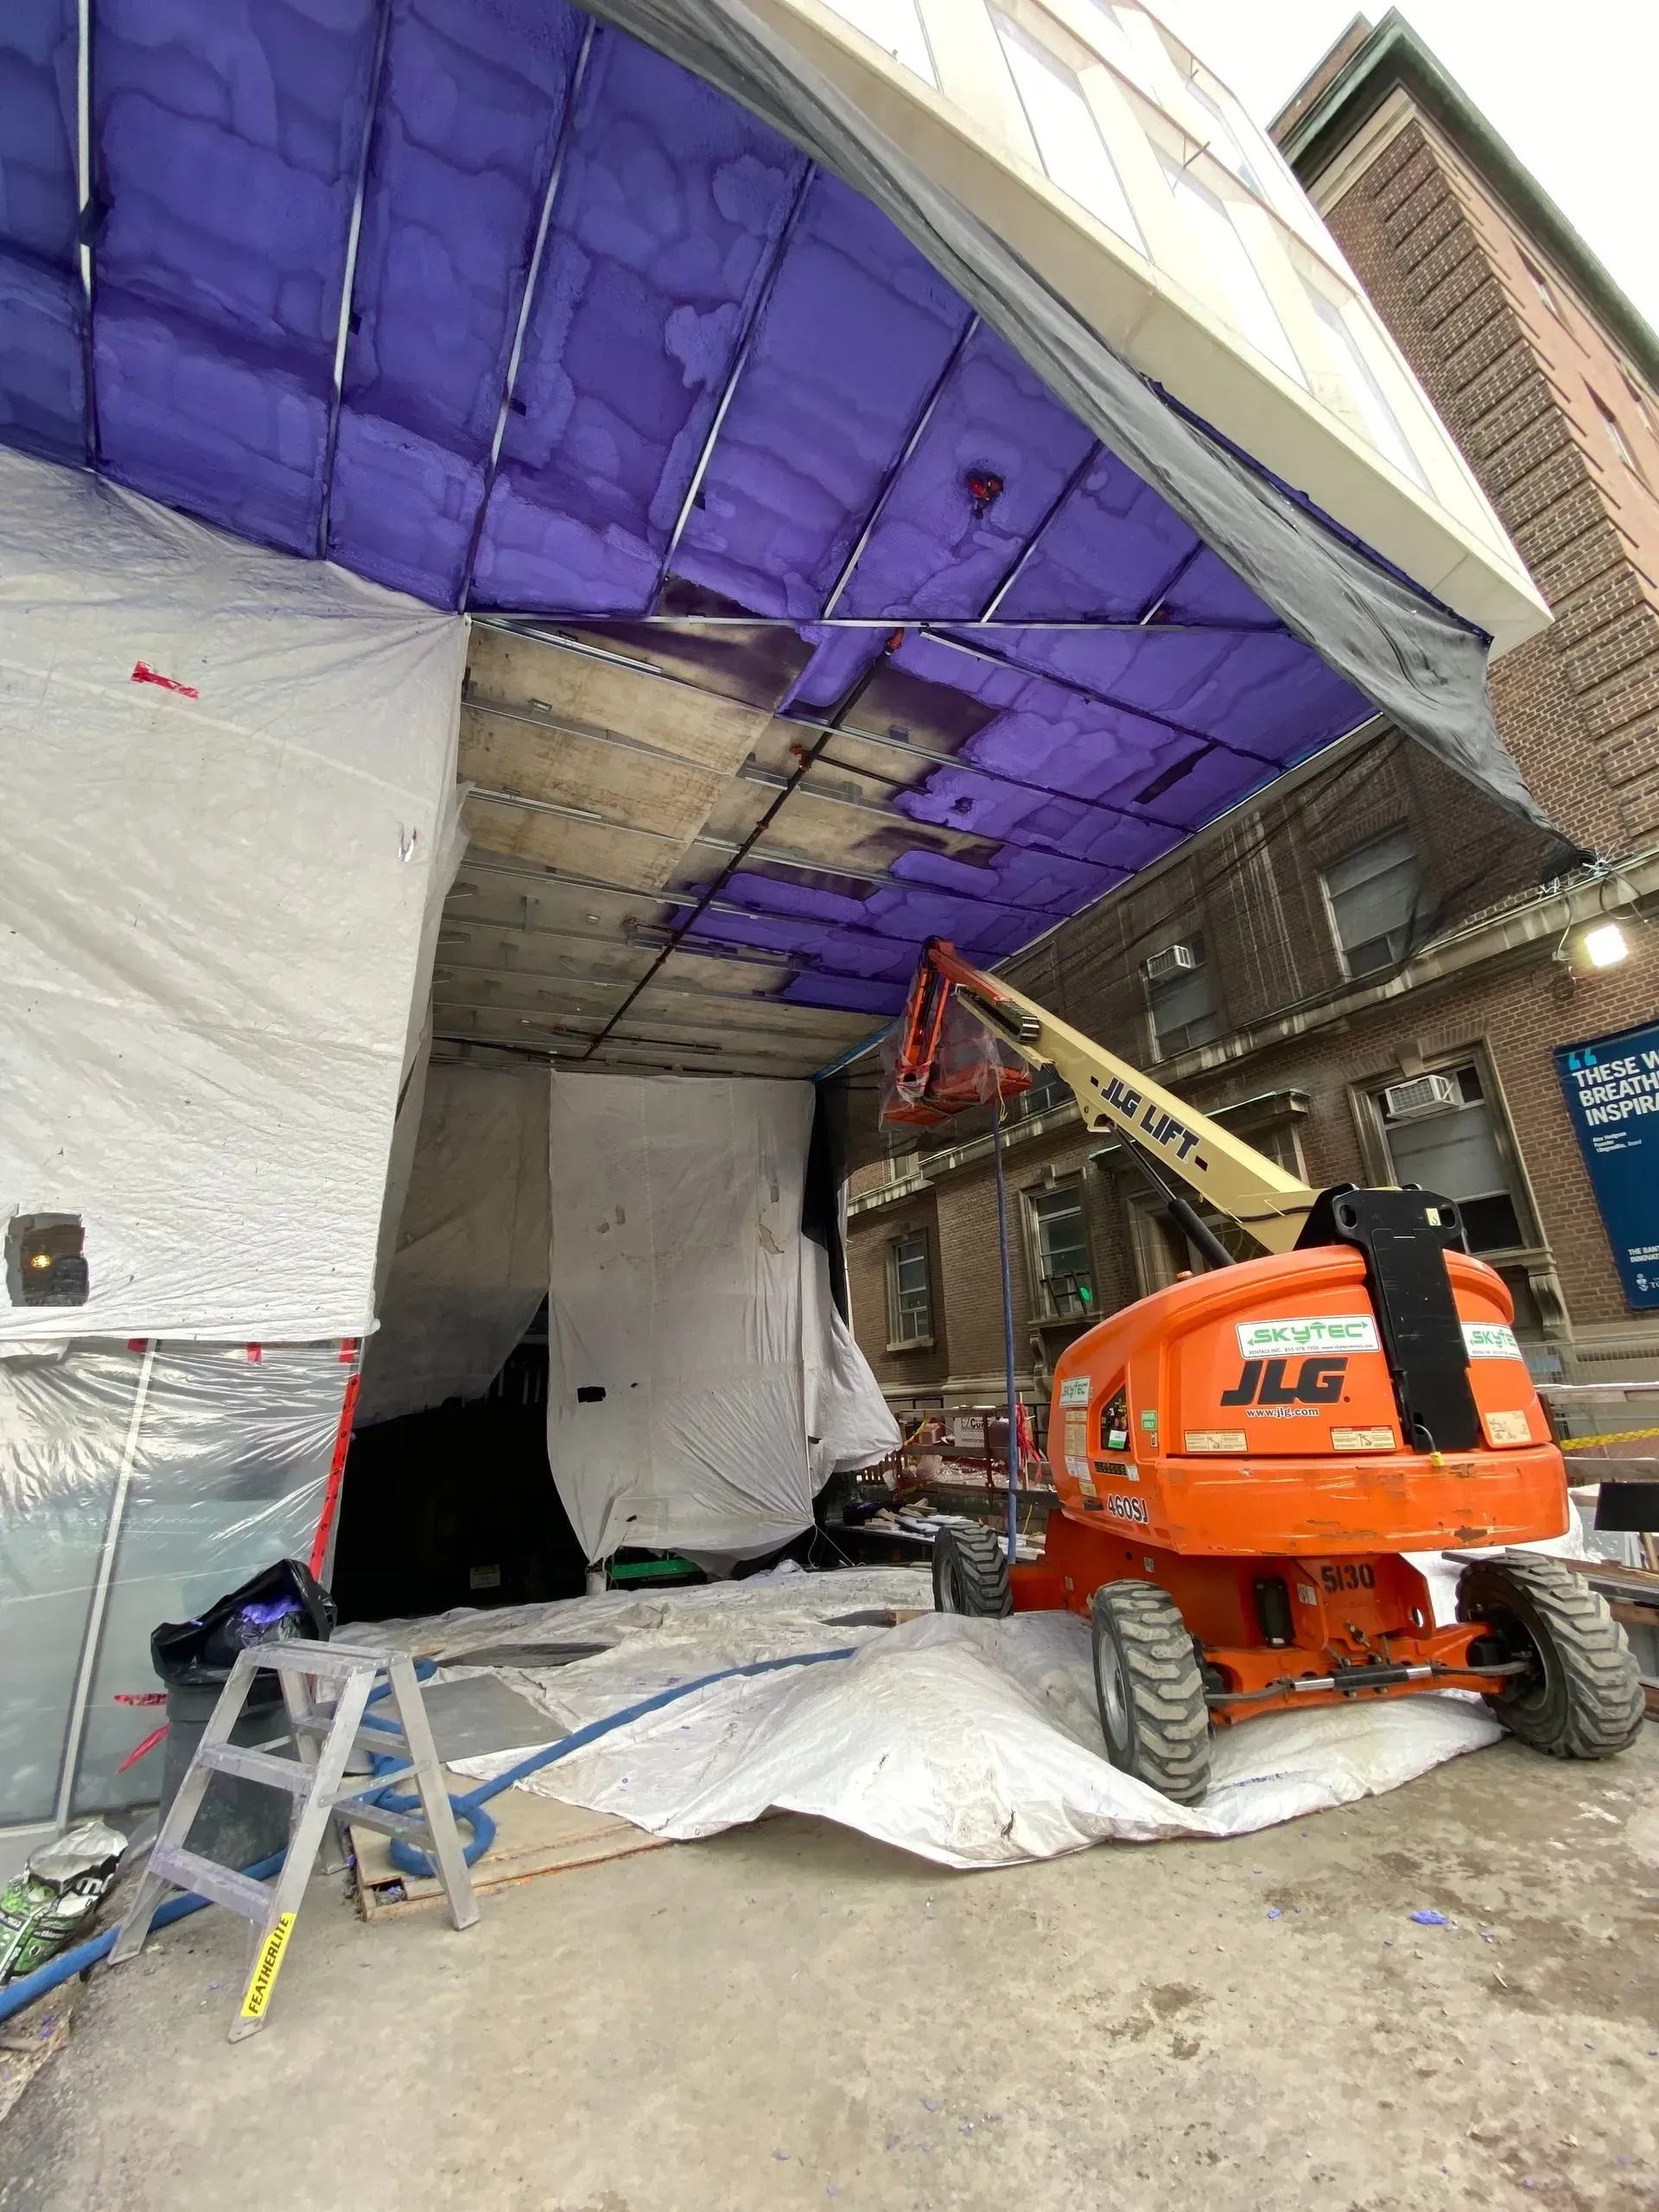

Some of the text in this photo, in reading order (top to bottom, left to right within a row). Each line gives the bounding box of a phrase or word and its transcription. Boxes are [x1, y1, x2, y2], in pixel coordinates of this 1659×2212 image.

[1572, 1056, 1640, 1087] THESE
[1579, 1071, 1659, 1107] BREATH
[1100, 1077, 1200, 1161] JLG LIFT
[1249, 1322, 1367, 1344] SKYTEC
[1220, 1357, 1348, 1406] JLG
[1246, 1408, 1319, 1417] www.jlg.com
[1107, 1494, 1149, 1523] 460SJ
[1320, 1563, 1375, 1593] 5130
[248, 1917, 289, 2013] FEATHERLITE
